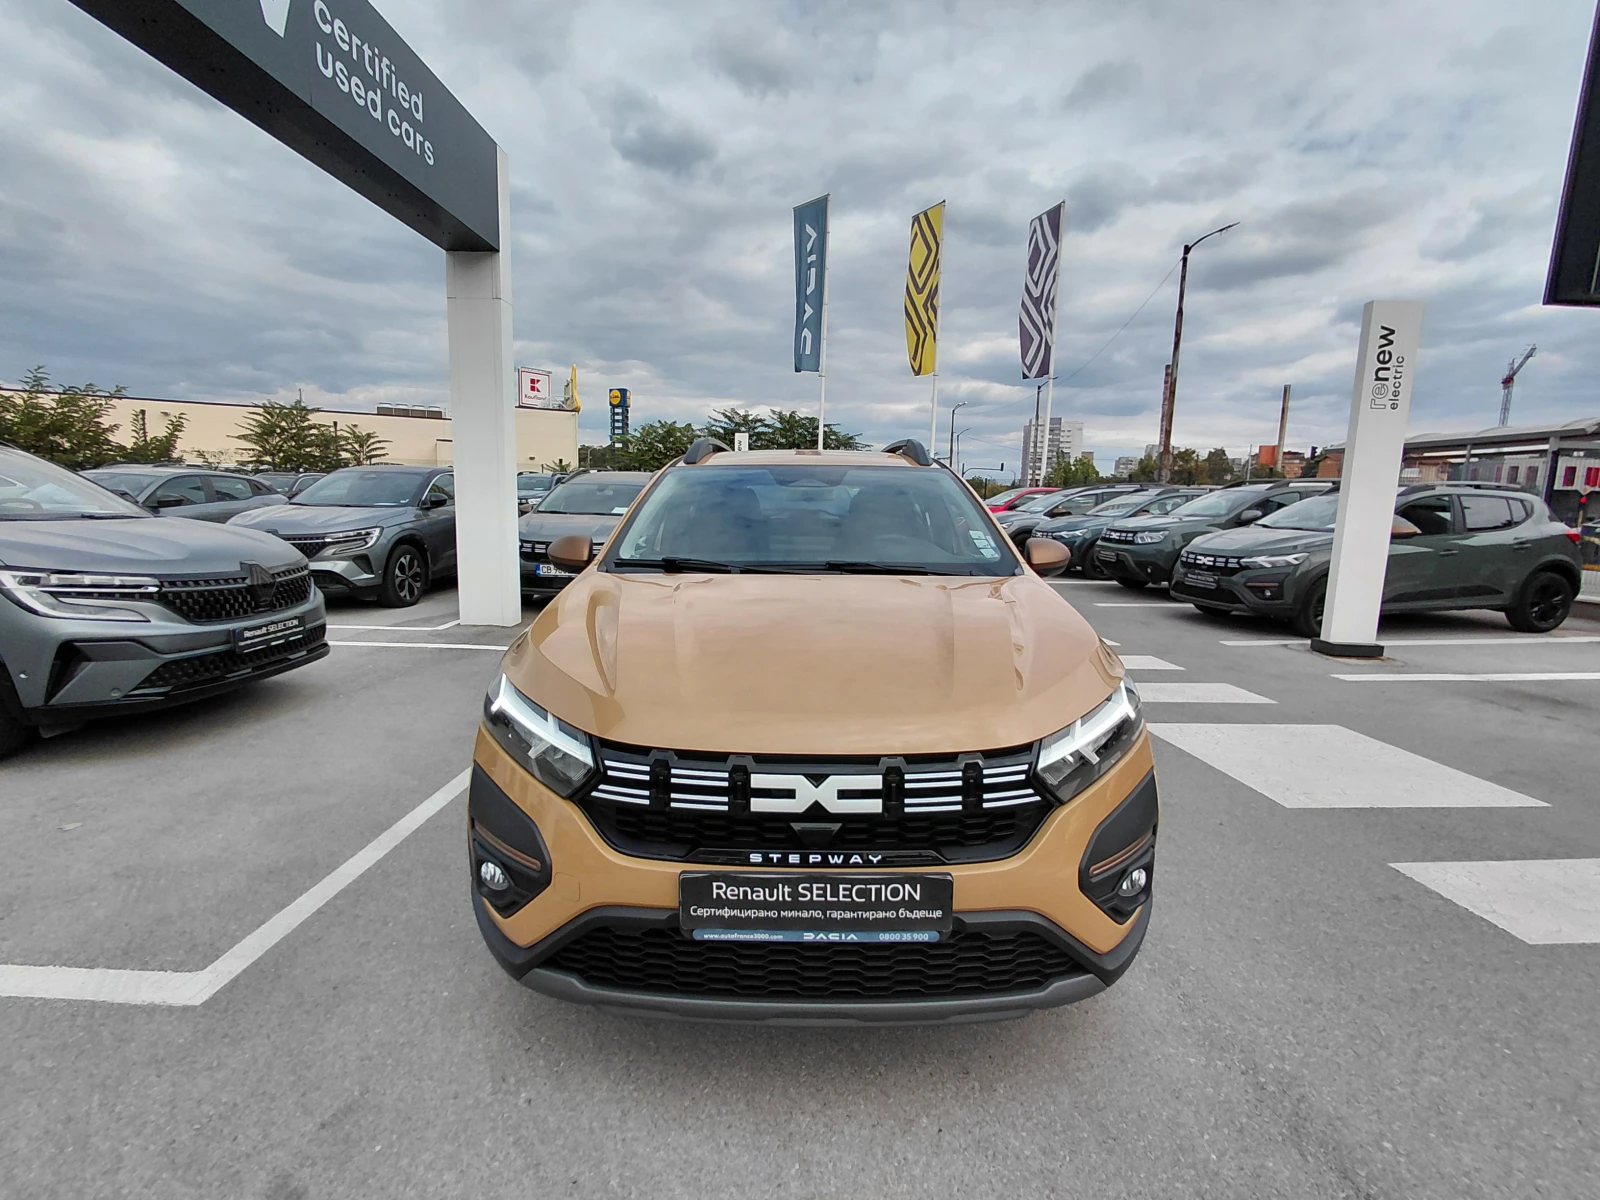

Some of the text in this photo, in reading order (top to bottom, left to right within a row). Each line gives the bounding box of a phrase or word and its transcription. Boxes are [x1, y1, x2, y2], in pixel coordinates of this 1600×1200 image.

[313, 0, 424, 123] certified
[316, 41, 435, 166] used cars
[1369, 325, 1396, 410] renew
[1388, 355, 1405, 410] electric
[268, 619, 299, 632] SELECTION
[750, 853, 882, 864] STEPWAY
[712, 881, 921, 902] Renault SELECTION
[690, 905, 943, 921] Сертифицирано минало, гарантирано бъдеще
[803, 932, 858, 940] DACIA
